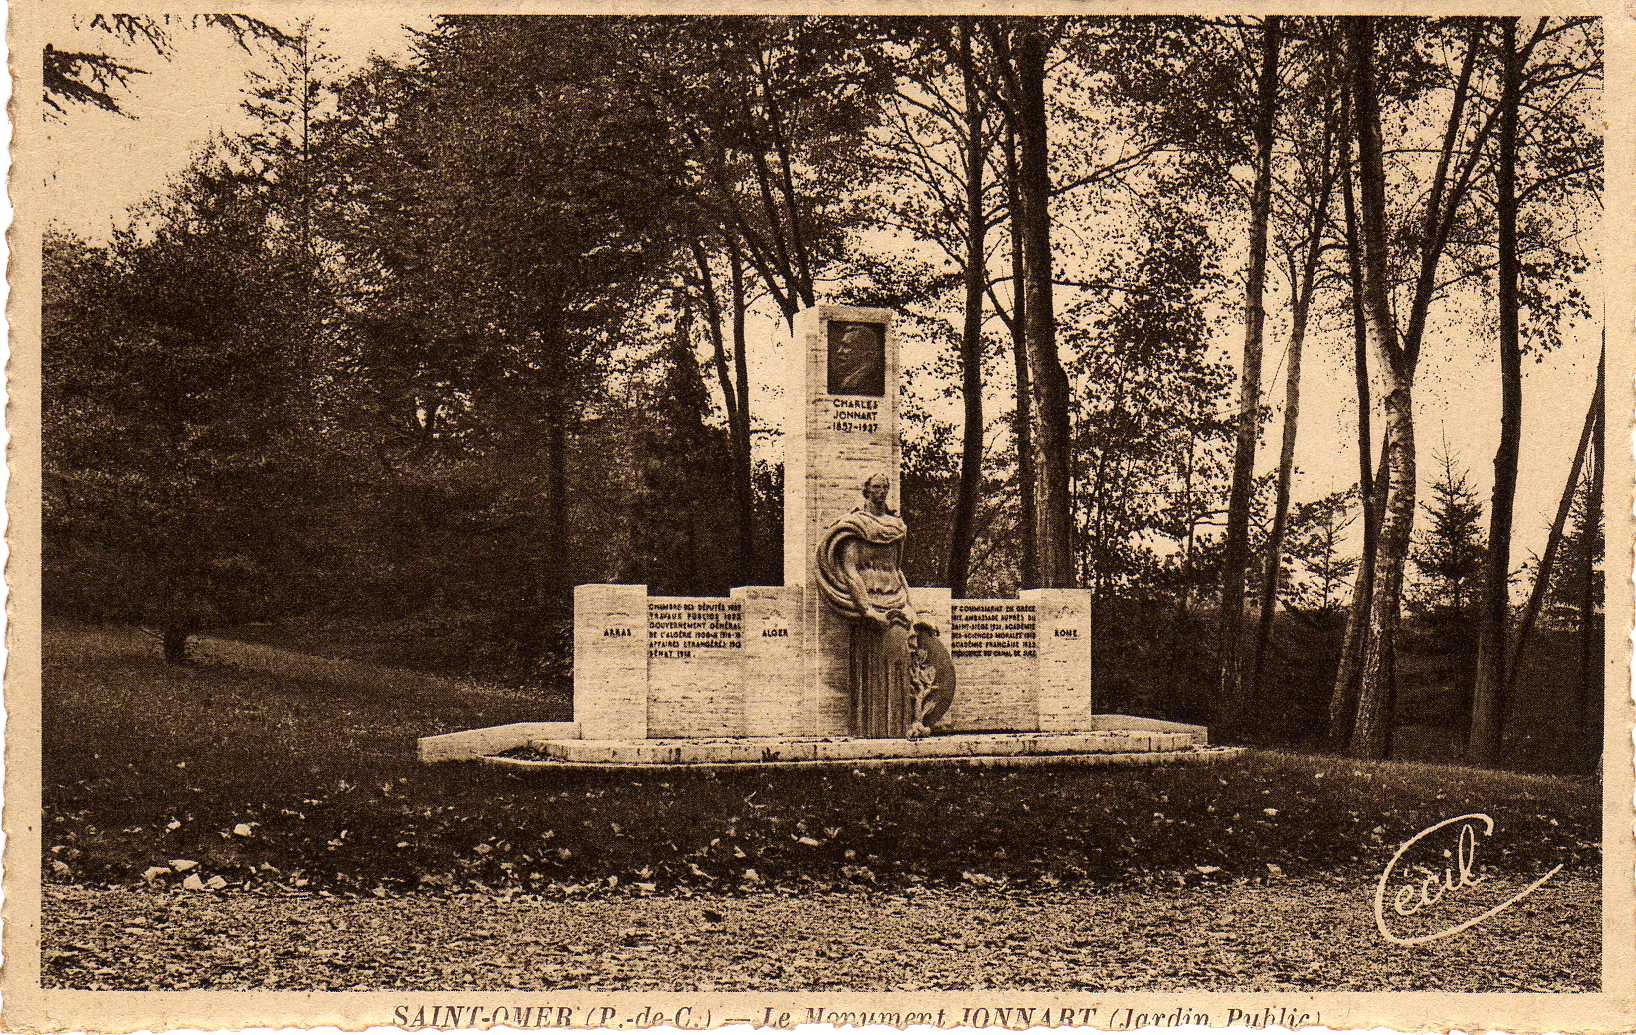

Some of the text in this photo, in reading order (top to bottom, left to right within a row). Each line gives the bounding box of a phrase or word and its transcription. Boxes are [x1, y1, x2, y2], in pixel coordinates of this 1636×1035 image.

[833, 399, 879, 410] CHARLES
[833, 410, 878, 421] JONNART
[648, 603, 682, 611] CHAMBRE
[683, 603, 695, 611] DES
[649, 612, 682, 621] TRAVAUX
[1027, 614, 1036, 622] DU
[649, 621, 706, 630] GOUVERNEMENT
[603, 628, 631, 637] ARRAS
[762, 628, 789, 638] ALGER
[1054, 629, 1078, 638] ROME
[649, 640, 680, 649] AFFAIRES
